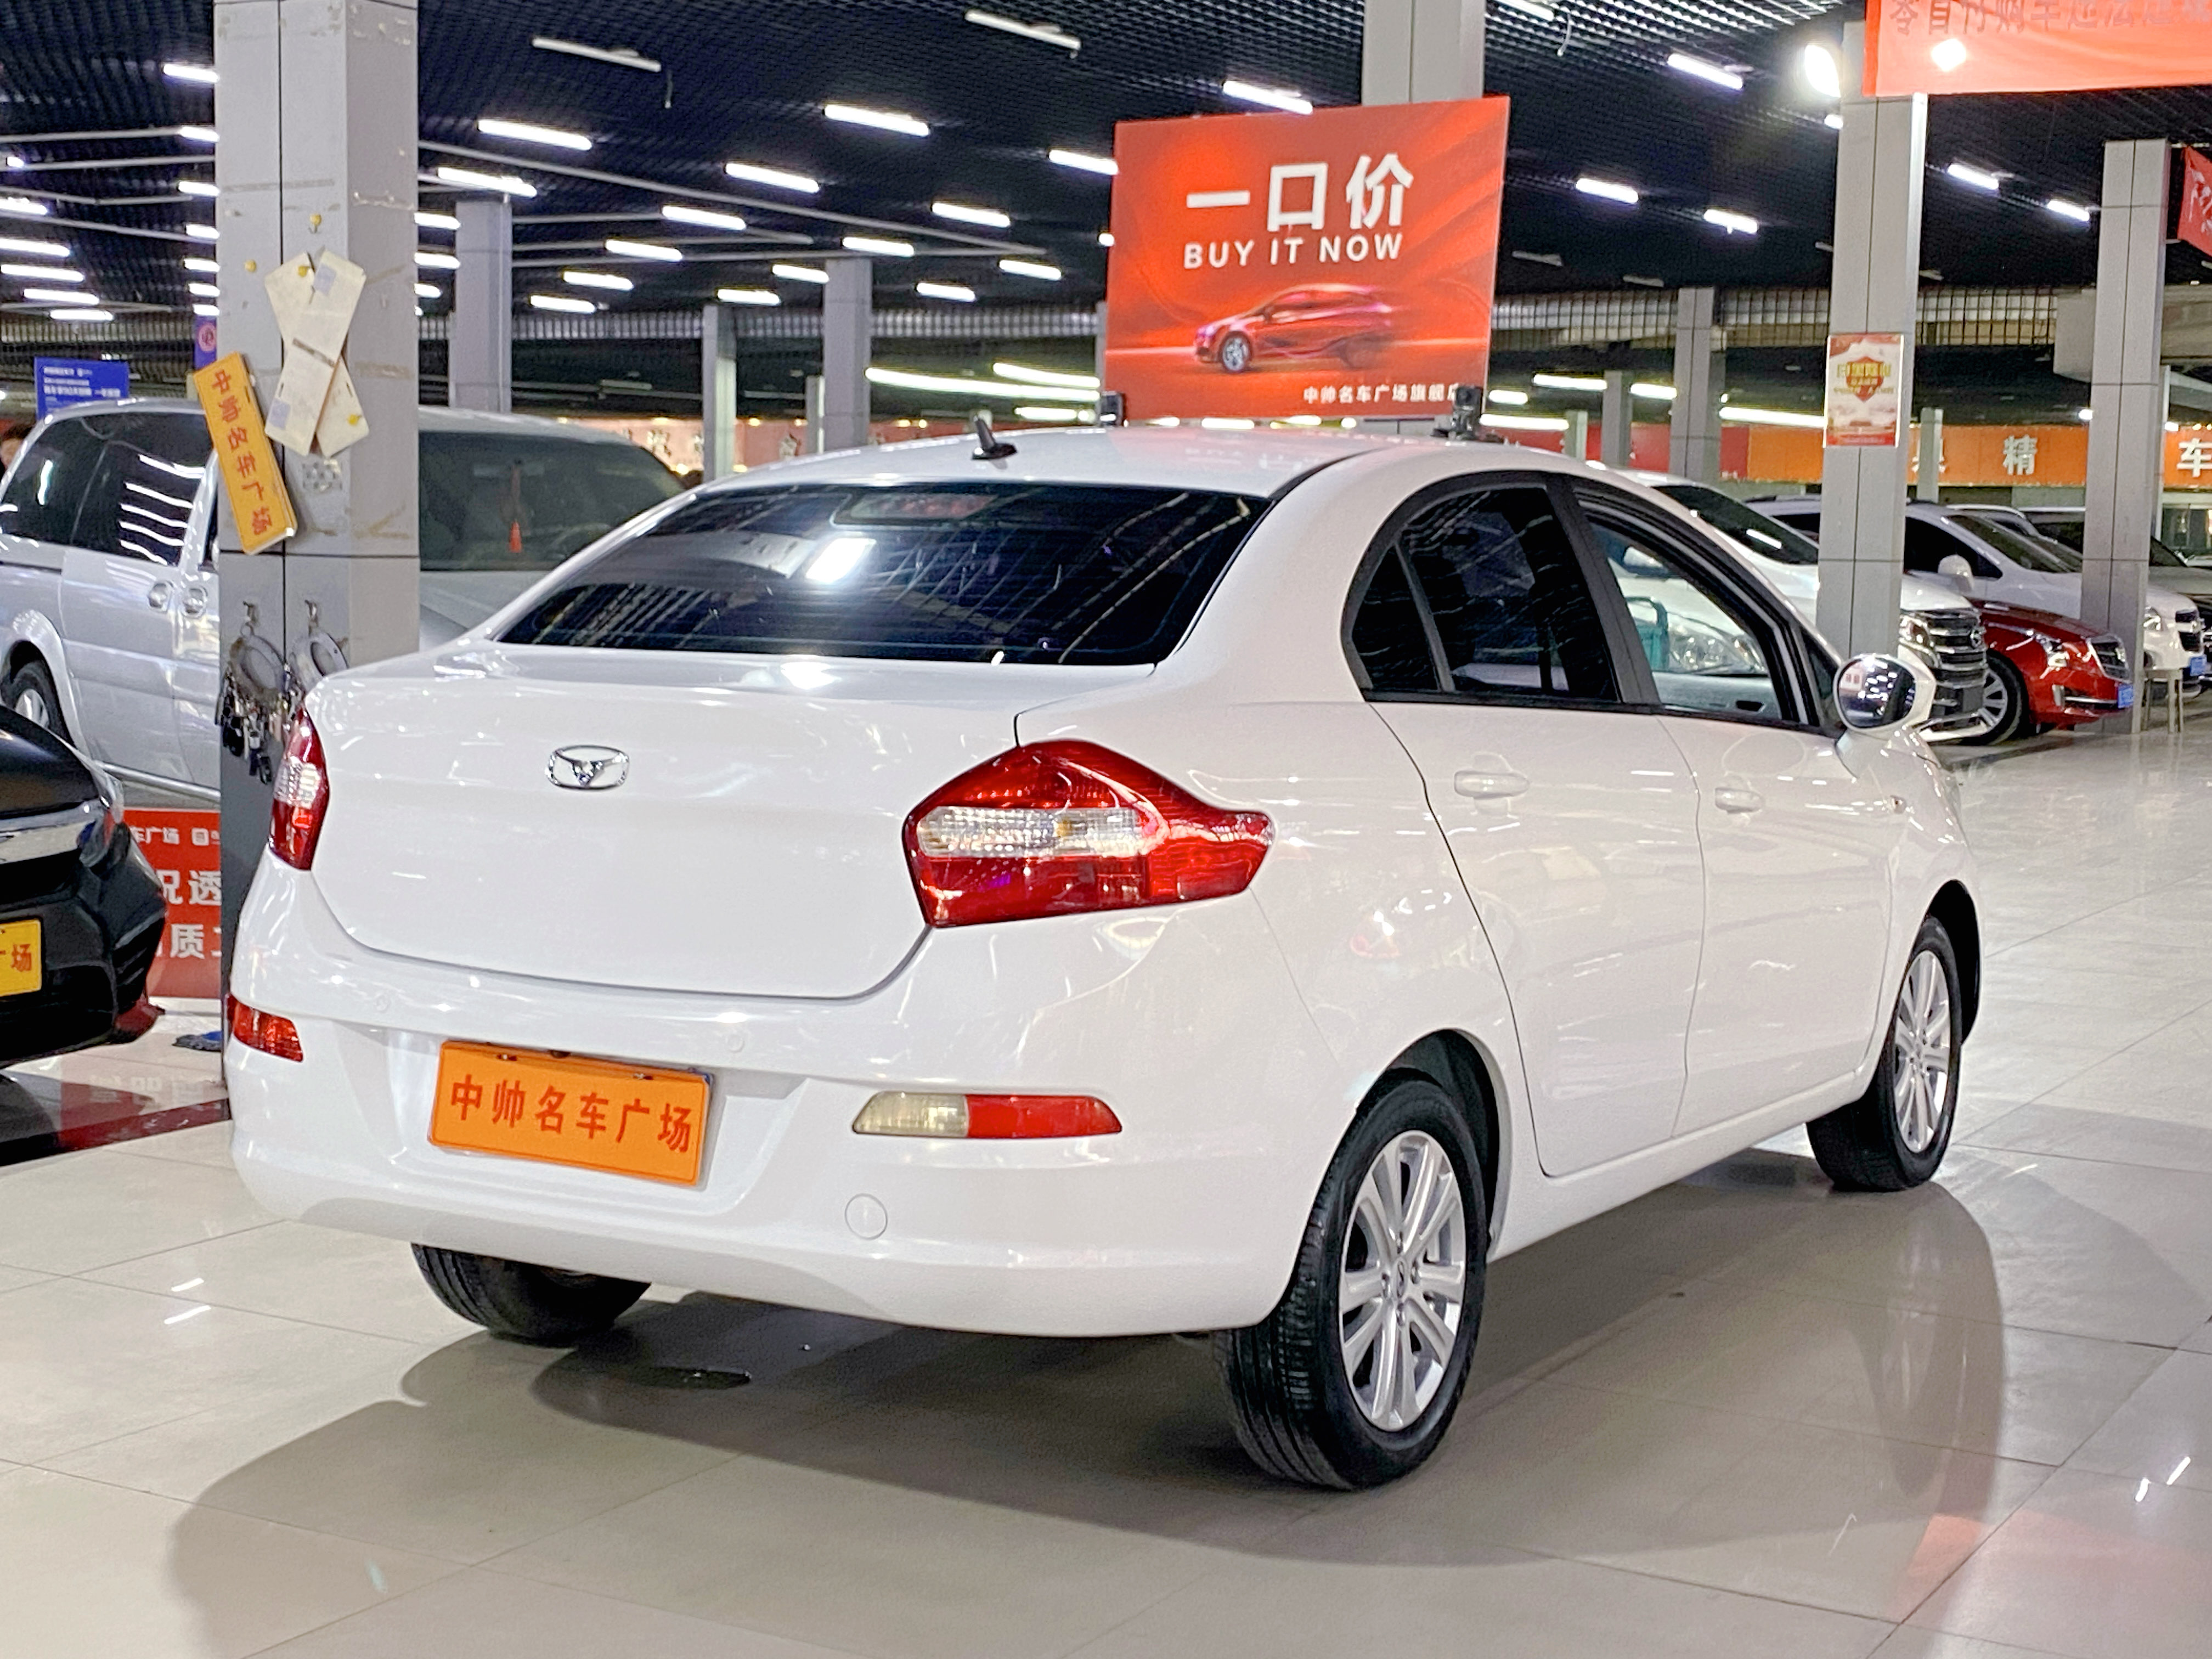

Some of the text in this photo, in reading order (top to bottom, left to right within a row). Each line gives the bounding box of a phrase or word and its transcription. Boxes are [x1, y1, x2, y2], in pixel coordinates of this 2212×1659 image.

[1186, 153, 1414, 232] 一口价
[1184, 232, 1403, 269] BUY IT NOW
[212, 369, 273, 535] 中帅名车广场
[2003, 435, 2212, 477] 精 车
[0, 944, 32, 972] 场
[451, 1074, 692, 1153] 中帅名车广场
